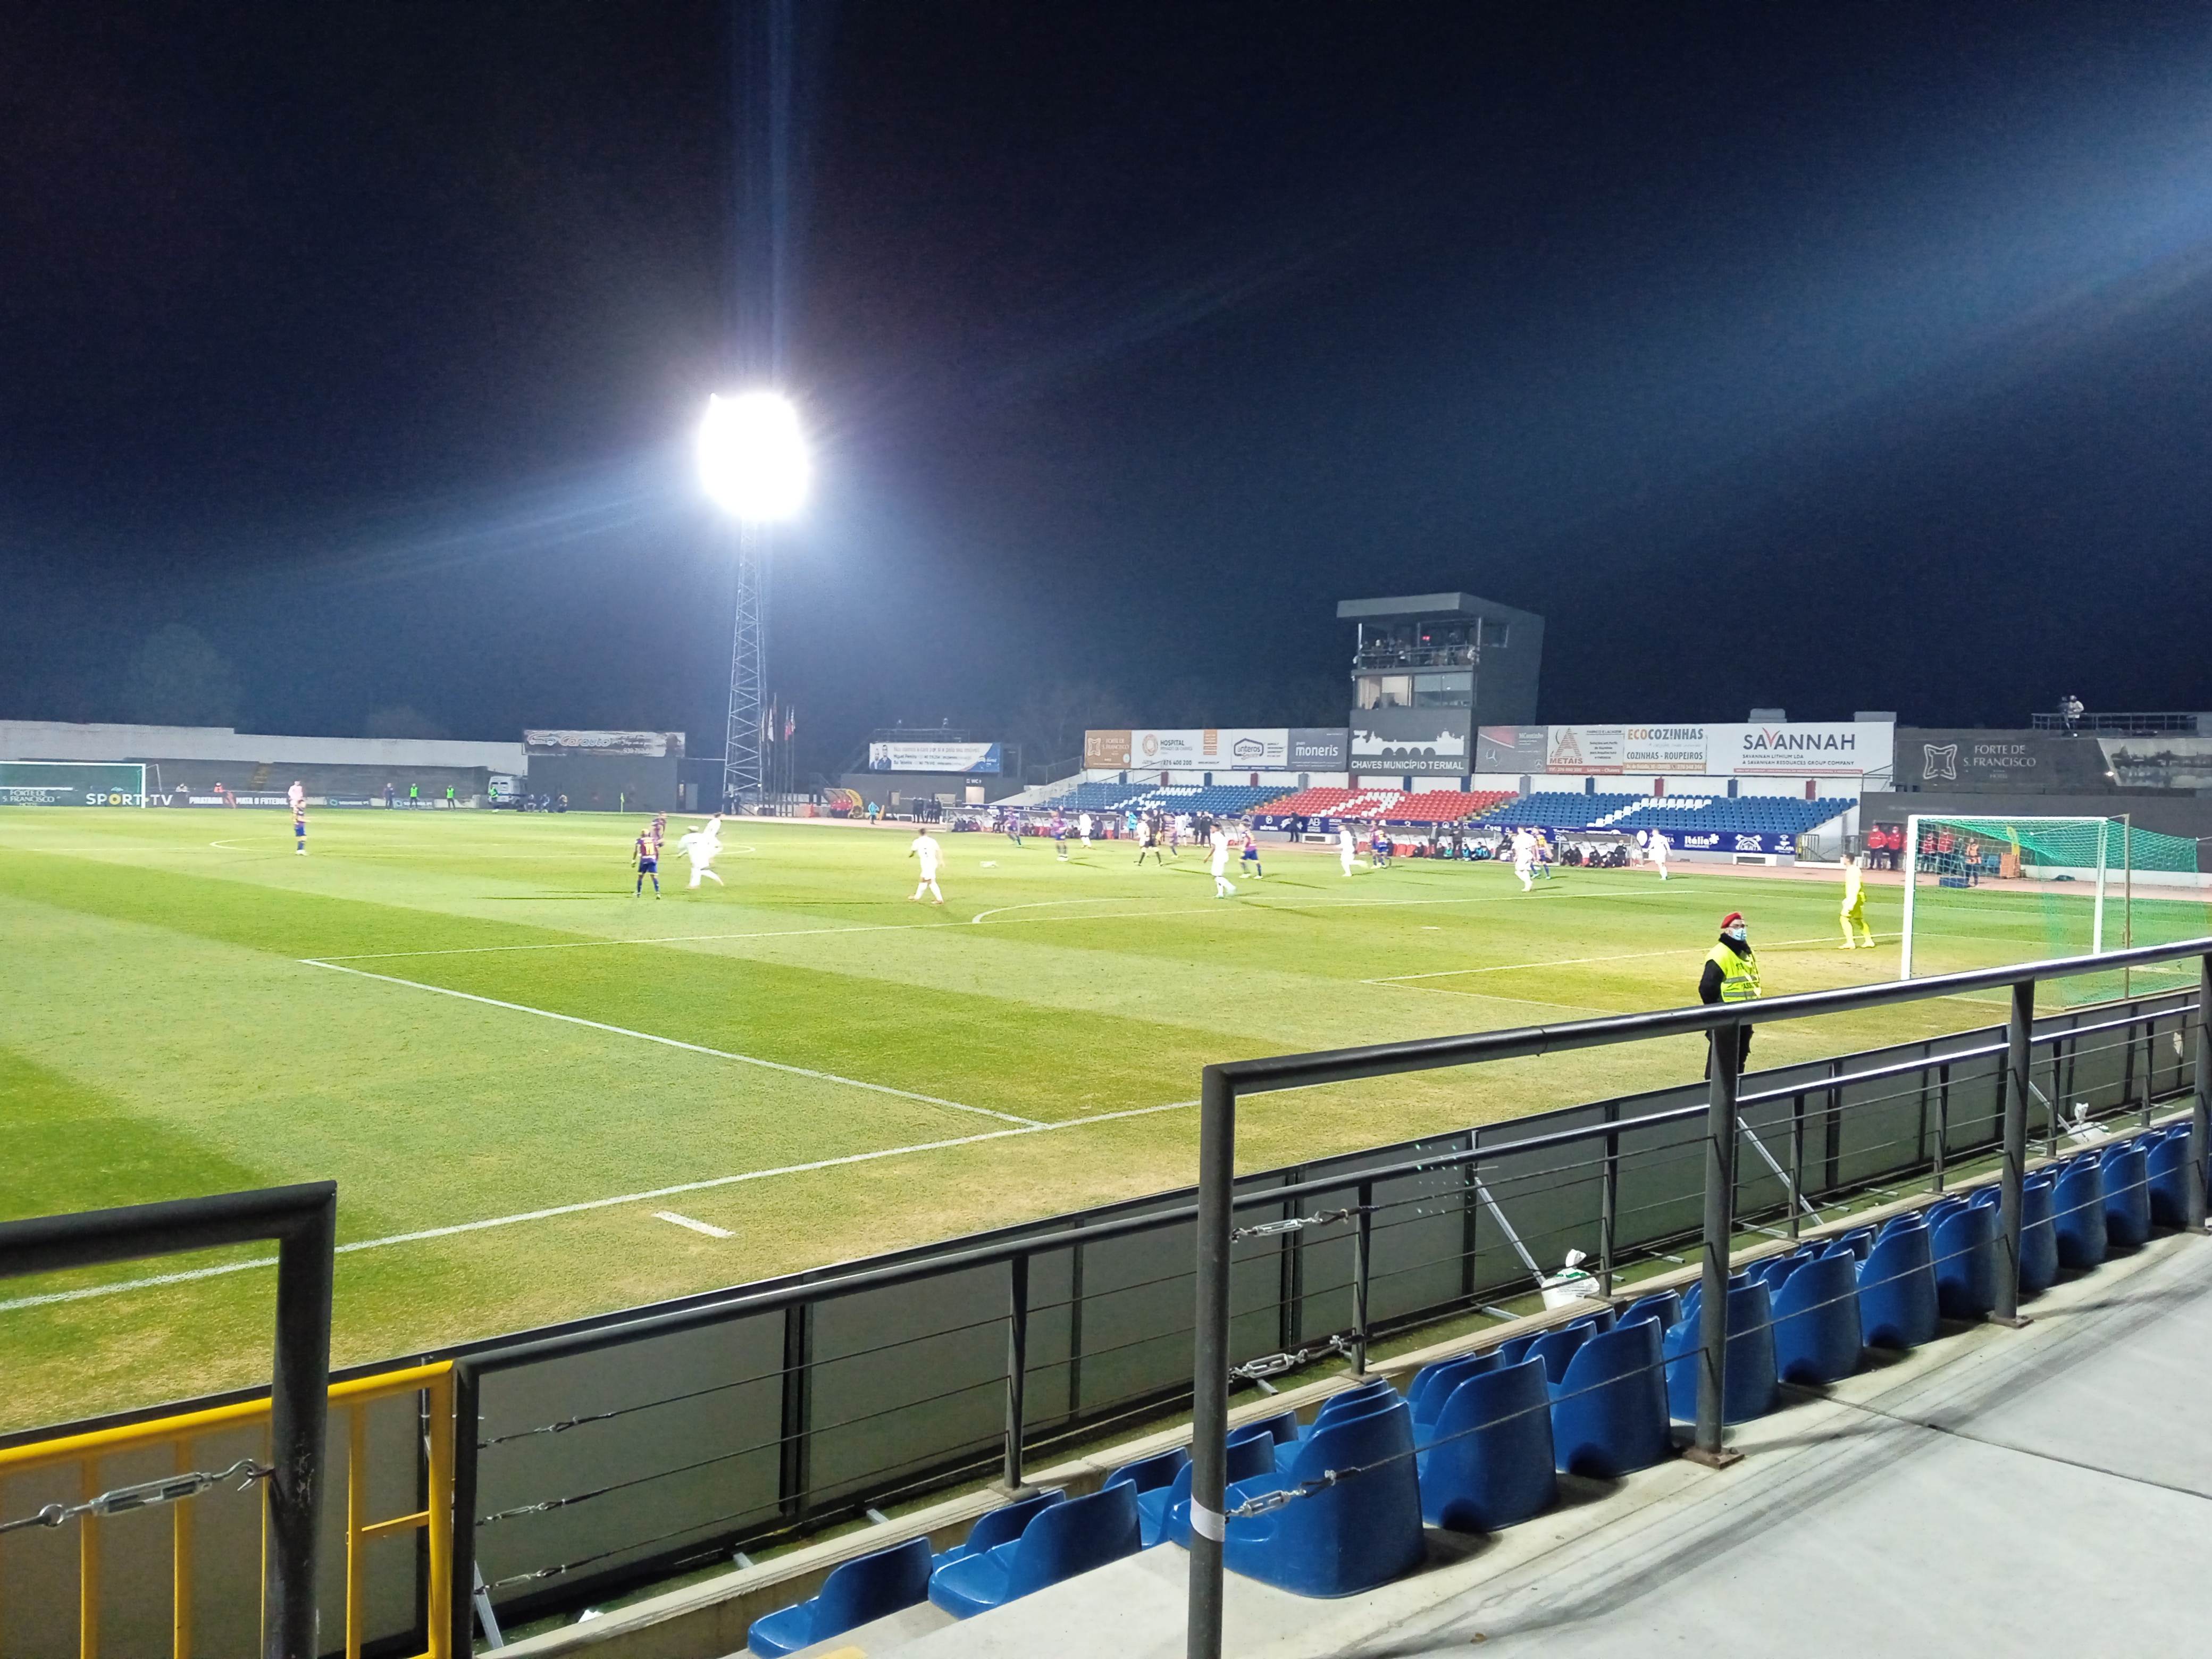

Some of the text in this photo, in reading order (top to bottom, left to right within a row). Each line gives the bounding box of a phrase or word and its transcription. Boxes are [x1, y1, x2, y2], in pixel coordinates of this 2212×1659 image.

[1743, 727, 1855, 750] SAVANNAH
[1295, 744, 1338, 756] moneris
[1974, 744, 2025, 755] FORTE DE
[1351, 759, 1464, 770] CHAVES MUNICÍPIO TERMAL
[1963, 757, 2037, 767] S. FRANCISCO
[149, 794, 173, 806] TV
[1685, 835, 1710, 845] Itália
